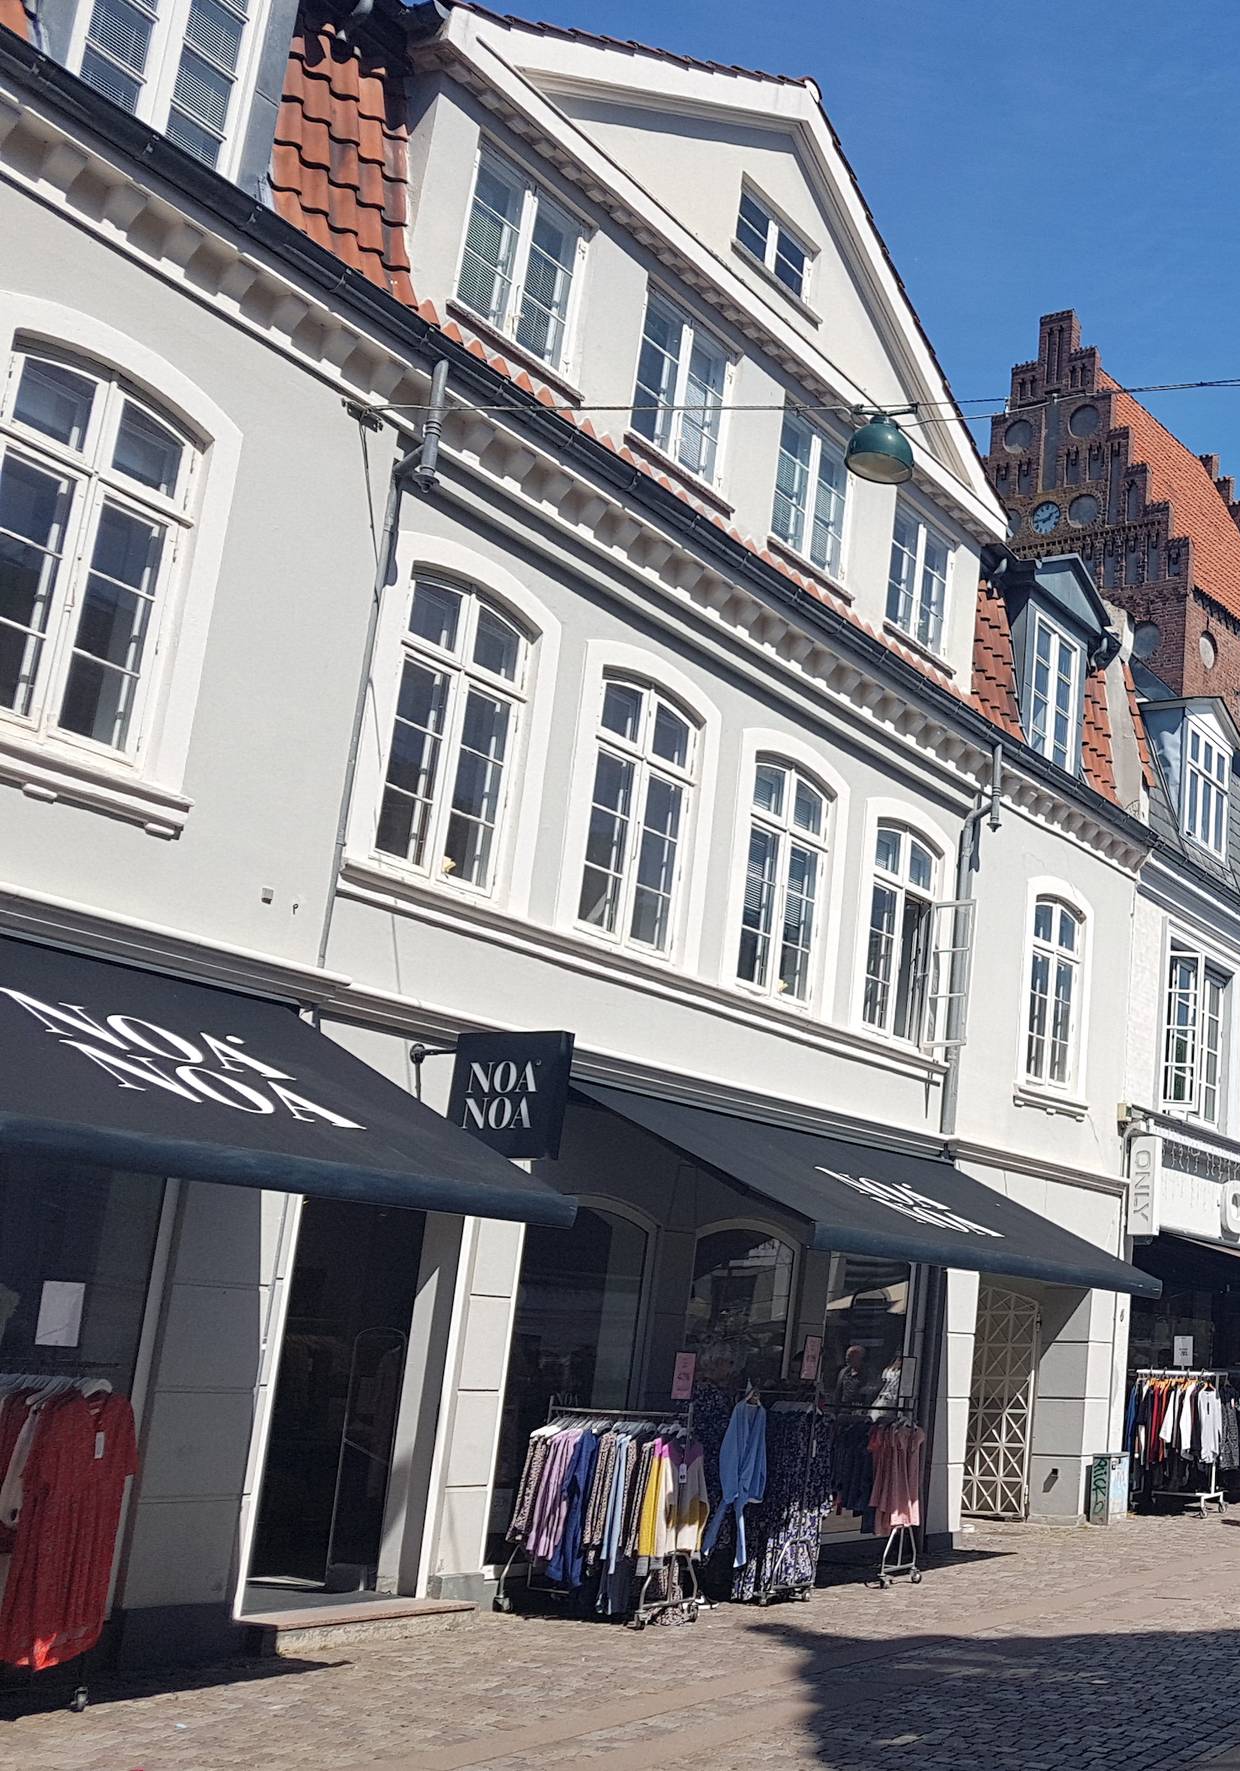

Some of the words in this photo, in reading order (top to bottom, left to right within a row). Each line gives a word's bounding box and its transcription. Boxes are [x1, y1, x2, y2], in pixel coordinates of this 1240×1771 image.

[59, 1039, 367, 1130] NOA
[461, 1096, 532, 1129] NOA
[1133, 1150, 1152, 1222] ONLY
[870, 1196, 1005, 1238] NOA
